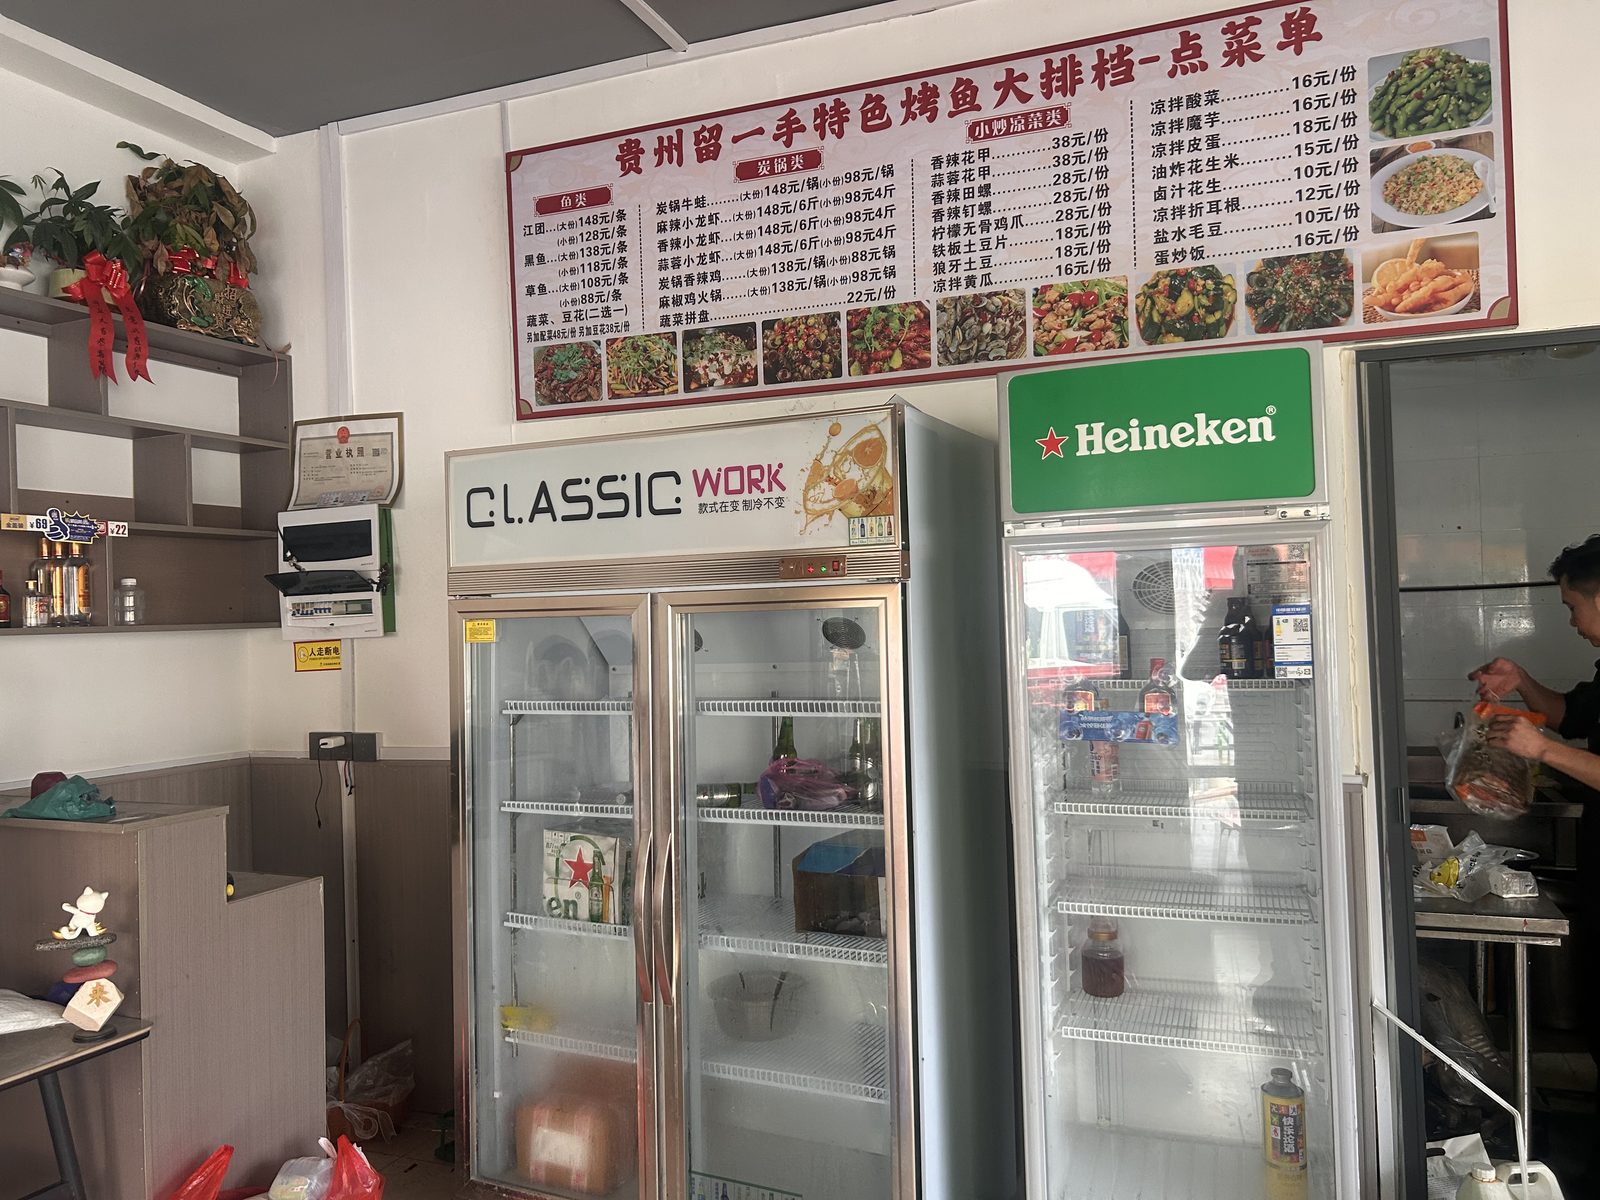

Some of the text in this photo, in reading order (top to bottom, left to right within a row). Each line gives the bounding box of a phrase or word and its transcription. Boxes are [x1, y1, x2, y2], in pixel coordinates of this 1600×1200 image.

[1150, 89, 1220, 115] 凉拌酸菜
[975, 109, 1062, 139] 小炒凉菜类
[1150, 111, 1221, 137] 凉拌魔芋
[1151, 133, 1221, 159] 凉拌皮蛋
[757, 154, 805, 176] 炭锅类
[930, 147, 990, 171] 香辣花甲
[1151, 152, 1240, 181] 油炸花生米
[930, 165, 991, 188] 蒜蓉花甲
[560, 192, 588, 208] 鱼类
[931, 183, 992, 206] 香辣田螺
[1153, 177, 1222, 202] 卤汁花生
[931, 201, 993, 224] 香辣钉螺
[1153, 197, 1241, 223] 凉拌折耳根
[931, 214, 1025, 241] 柠檬无骨鸡爪
[1153, 221, 1223, 245] 盐水毛豆
[932, 234, 1008, 259] 铁板土豆片
[1154, 245, 1206, 267] 蛋炒饭
[932, 254, 993, 276] 狼牙土豆
[933, 272, 994, 294] 凉拌黄瓜
[659, 309, 710, 329] 蔬菜拼盘
[1075, 412, 1276, 457] Heineken
[466, 462, 787, 529] CLASSIC WORK
[698, 496, 785, 515] 款式在变 制冷不变
[110, 524, 127, 535] ¥22
[309, 646, 341, 657] 人走断电
